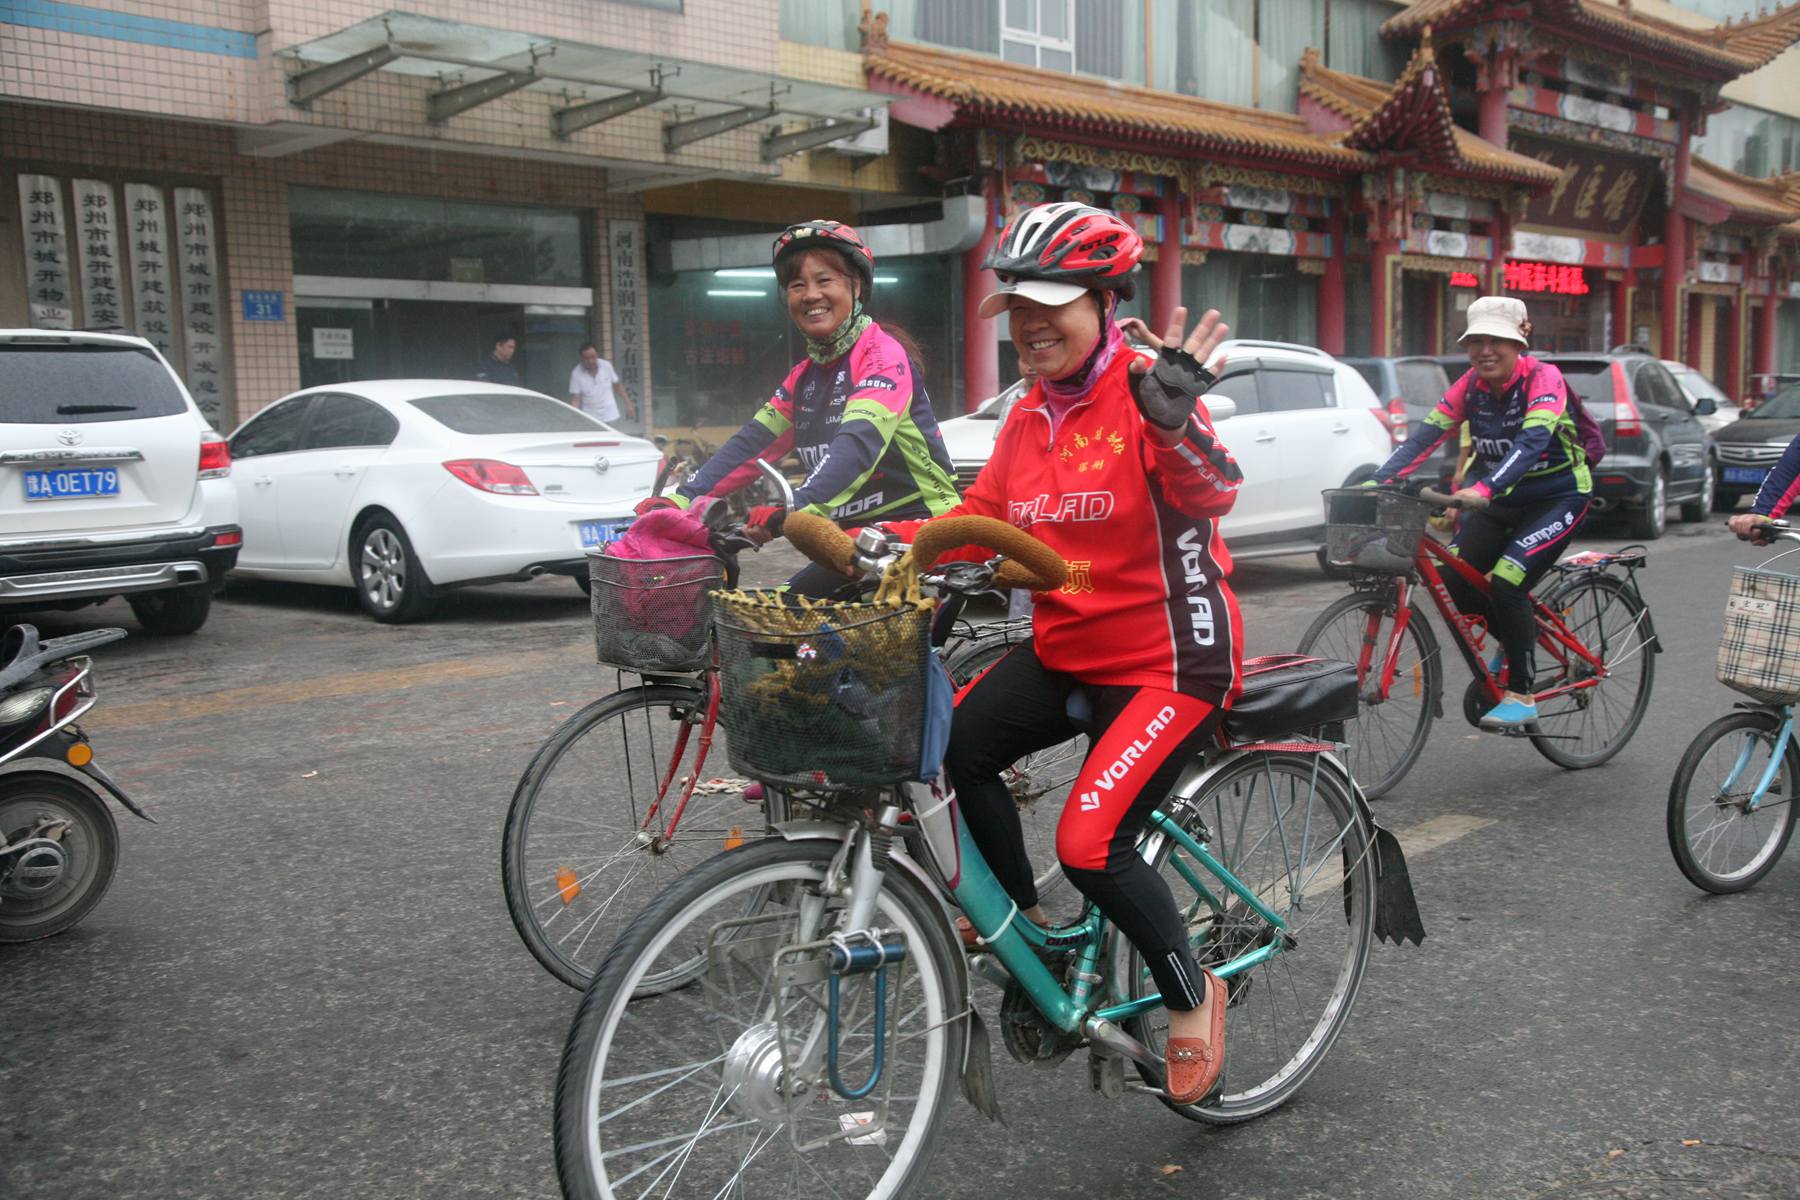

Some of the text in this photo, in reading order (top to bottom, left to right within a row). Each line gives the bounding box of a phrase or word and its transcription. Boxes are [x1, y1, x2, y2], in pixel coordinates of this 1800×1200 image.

[29, 191, 65, 321] 郑州市城开物业
[1176, 527, 1215, 647] VORAD
[1094, 705, 1176, 791] VORLAD
